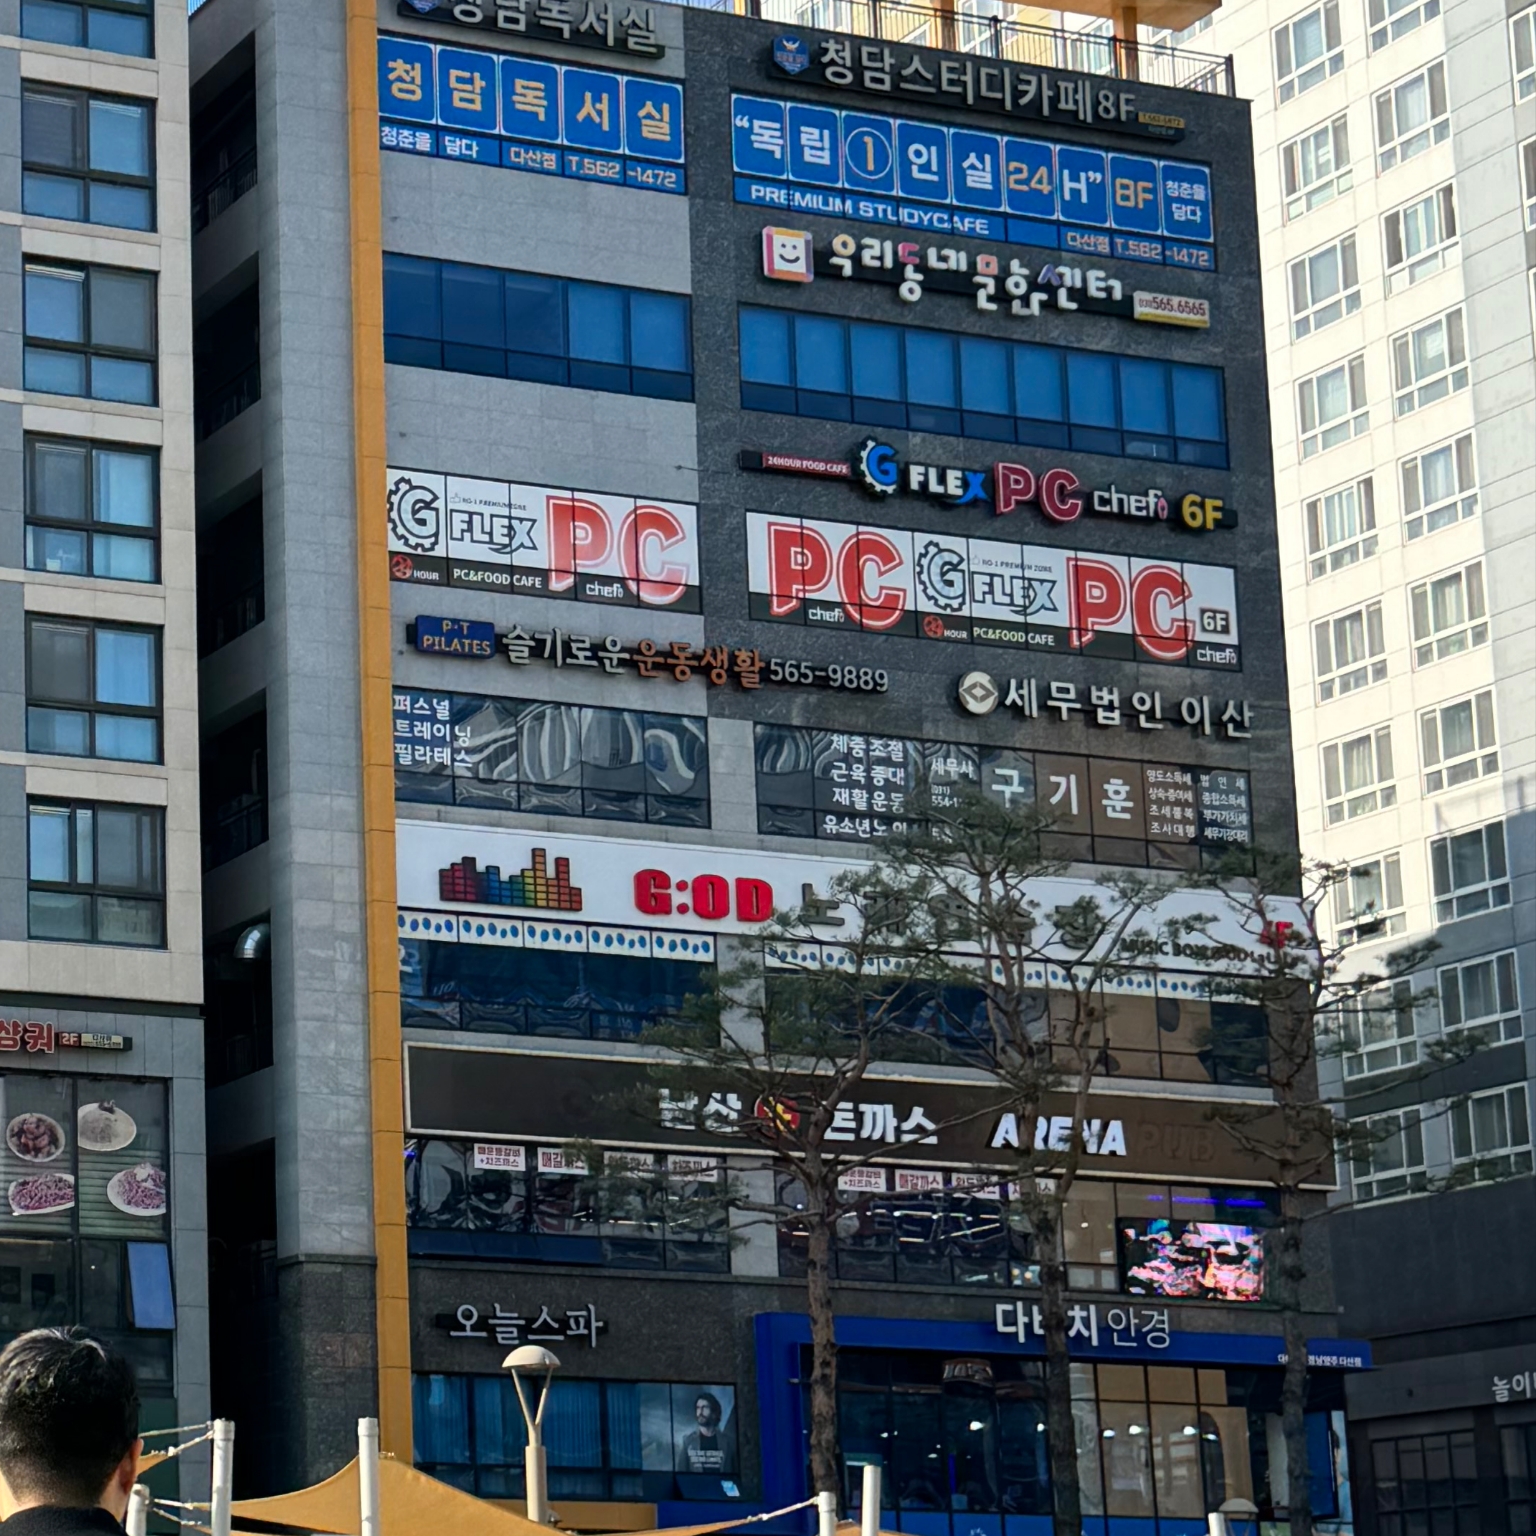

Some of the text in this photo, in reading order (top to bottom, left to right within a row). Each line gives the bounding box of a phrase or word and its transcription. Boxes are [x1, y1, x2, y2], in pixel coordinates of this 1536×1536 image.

[387, 58, 671, 142] 청담독서실
[380, 126, 432, 152] 청춘을
[444, 135, 479, 159] 담다
[1114, 177, 1154, 209] 8F
[1165, 180, 1206, 202] 청춘을
[750, 184, 854, 215] PREMIUM
[858, 202, 990, 235] STUDYCAFE
[1171, 202, 1202, 224] 담다
[802, 459, 826, 471] FOOD
[826, 462, 849, 474] CAFE
[865, 443, 898, 487] G
[908, 464, 990, 503] FLEX
[995, 461, 1083, 521] PC
[1181, 493, 1224, 530] 6F
[395, 484, 691, 606] G FLEX PC
[413, 569, 440, 581] HOUR
[452, 568, 510, 585] PC&FOOD
[512, 574, 543, 589] CAFE
[768, 521, 908, 631] PC
[925, 547, 1227, 661] G FLEX PC 6F
[422, 636, 491, 655] PILATES
[943, 629, 968, 639] HOUR
[972, 626, 1026, 643] PC&FOOD
[1027, 632, 1056, 646] CAFE
[502, 624, 889, 693] 슬기로운 운동생활 565-9889
[393, 694, 450, 720] 퍼스널
[1004, 677, 1255, 739] 세무법인 이산
[394, 719, 471, 748] 트레이닝
[830, 733, 904, 762] 체중조절
[394, 743, 473, 768] 필라테스
[930, 757, 975, 779] 세무사
[831, 761, 905, 787] 근육증대
[832, 787, 905, 814] 재활운동
[991, 768, 1135, 820] 구기훈
[61, 1032, 80, 1046] 2F
[1107, 1307, 1171, 1349] 안경
[1491, 1370, 1536, 1403] 놀이
